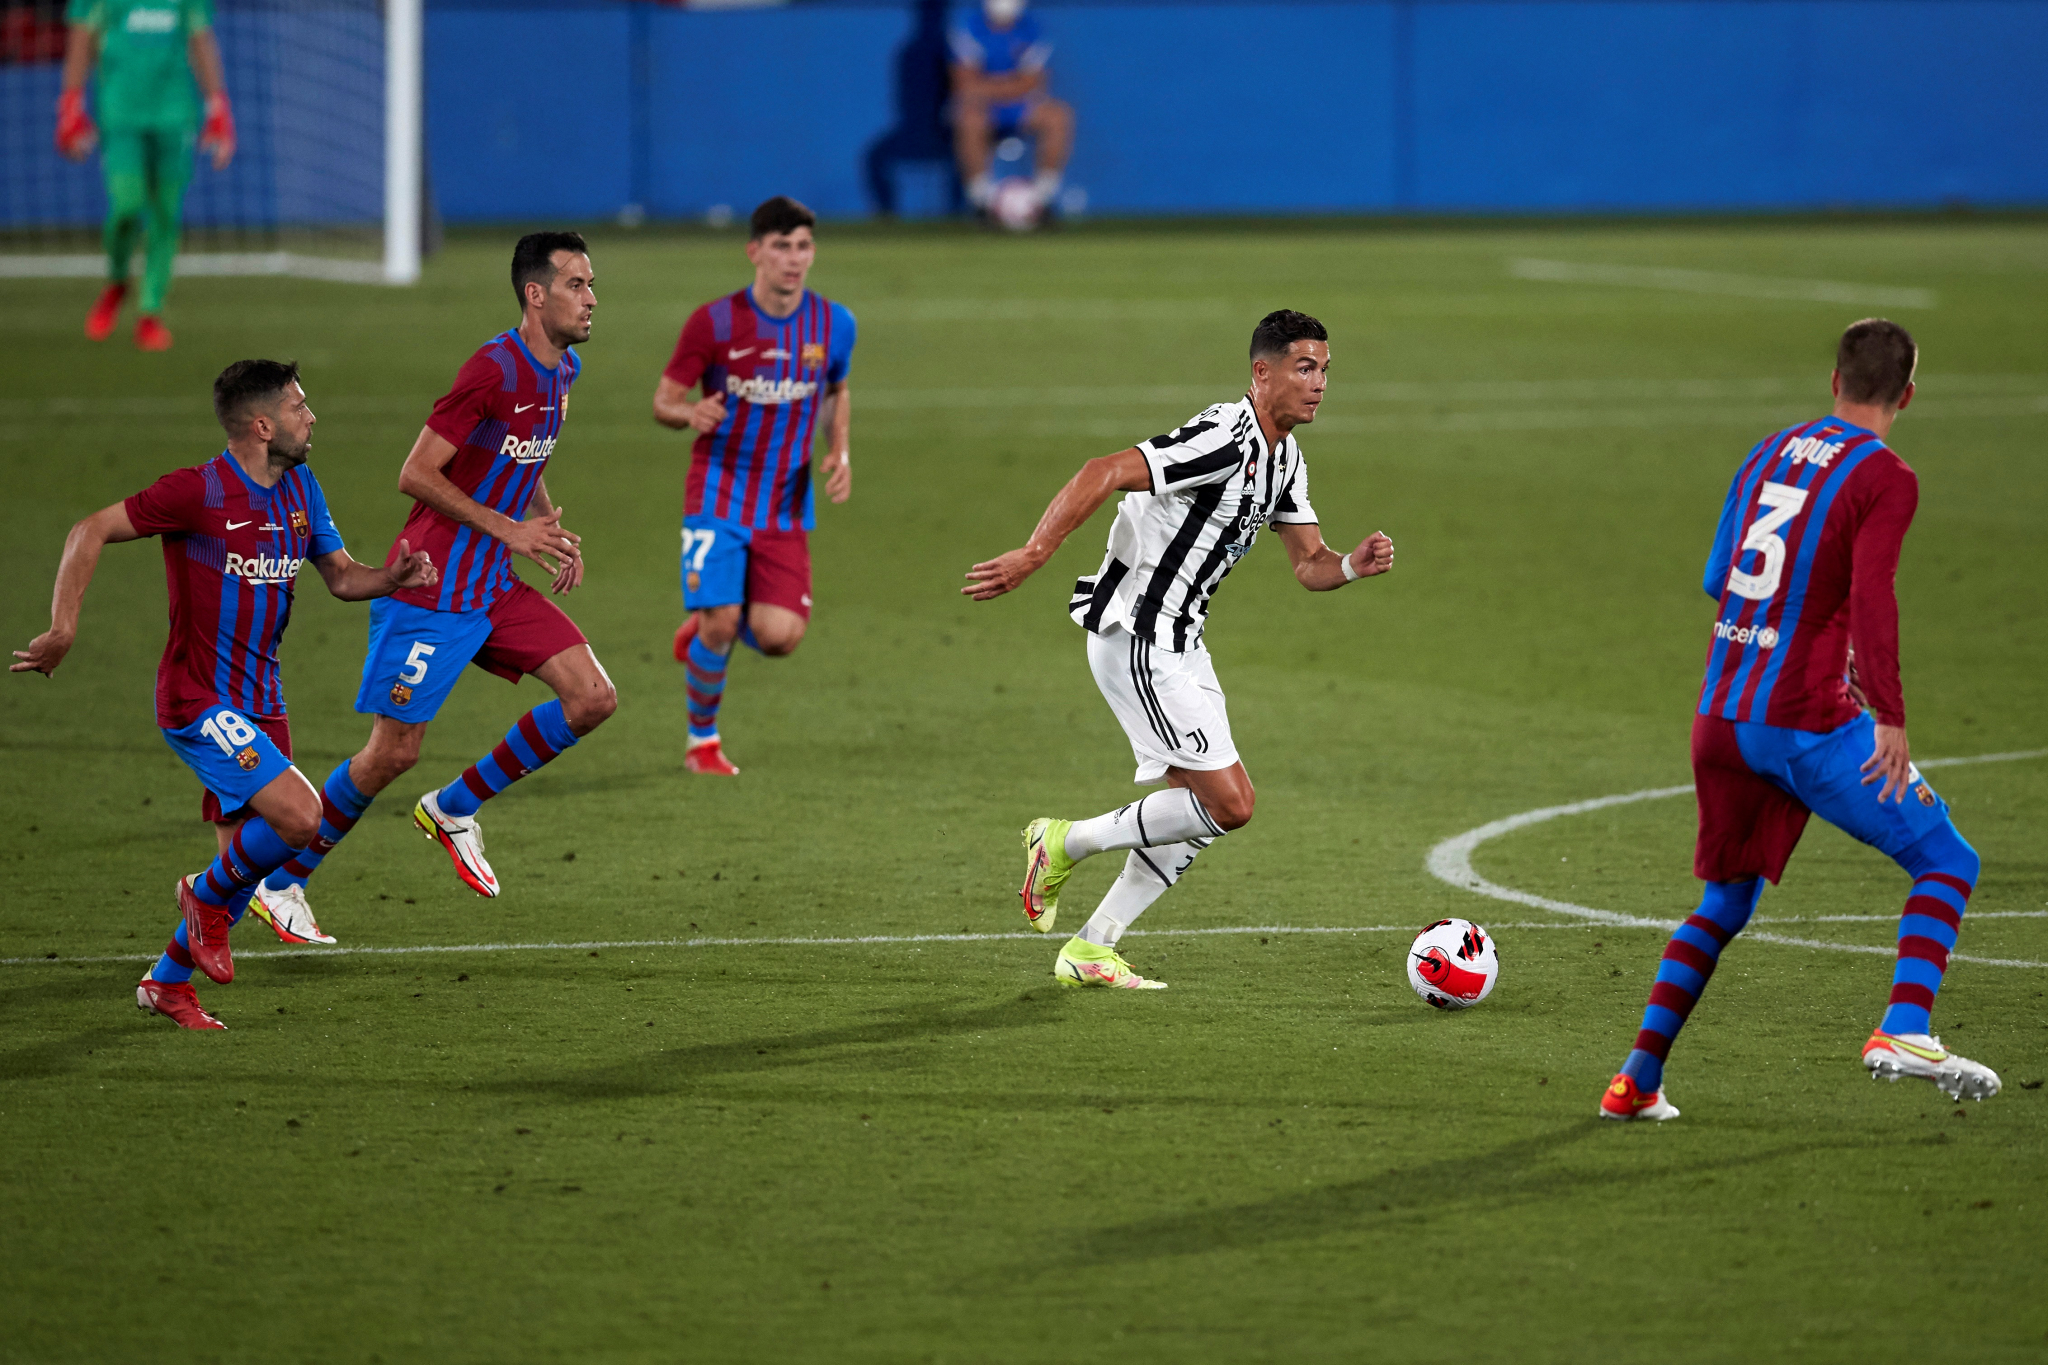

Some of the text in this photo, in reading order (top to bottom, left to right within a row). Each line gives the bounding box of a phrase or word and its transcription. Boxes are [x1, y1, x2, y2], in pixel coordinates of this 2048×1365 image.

[499, 434, 557, 458] Rakute
[1239, 503, 1268, 532] Jee
[1726, 480, 1809, 600] 3
[1713, 619, 1759, 645] nicef
[398, 641, 436, 685] 5
[200, 710, 257, 757] 18
